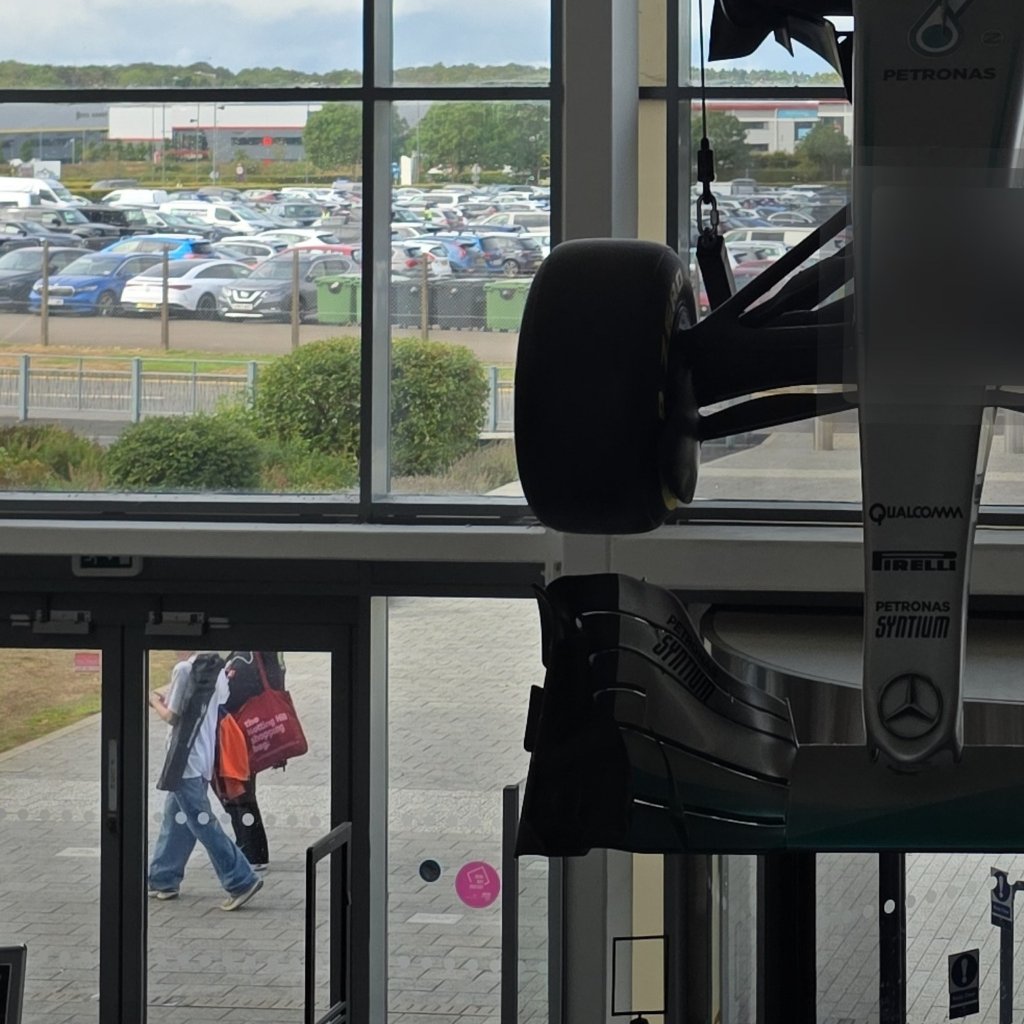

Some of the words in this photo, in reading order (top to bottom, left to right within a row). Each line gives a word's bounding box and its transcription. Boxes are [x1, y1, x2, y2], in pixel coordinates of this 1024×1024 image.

[883, 67, 996, 81] PETRONAS
[872, 551, 957, 571] PIRELLI
[875, 601, 951, 612] PETRONAS
[875, 615, 950, 638] SYNTIUM
